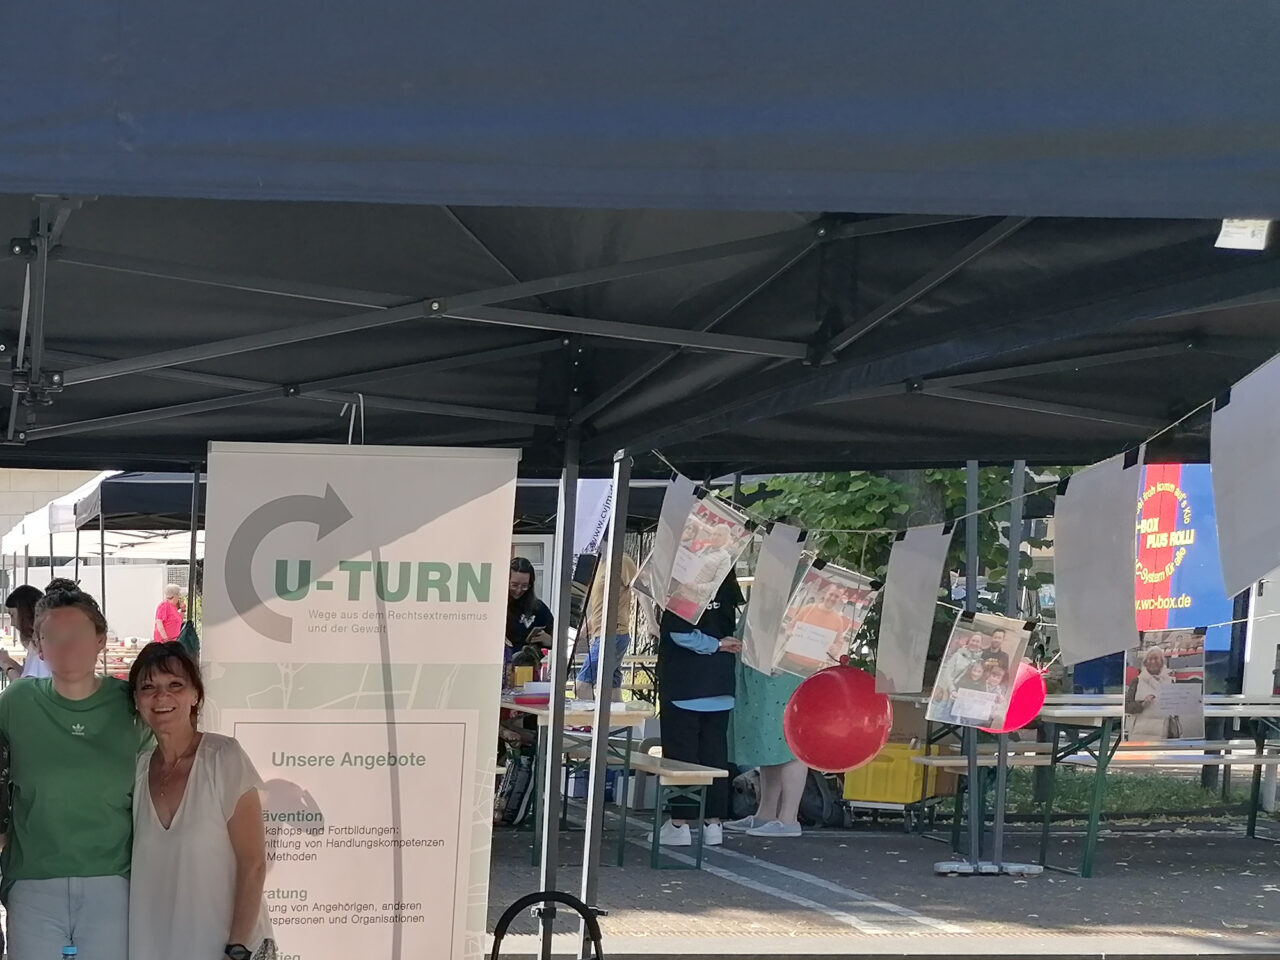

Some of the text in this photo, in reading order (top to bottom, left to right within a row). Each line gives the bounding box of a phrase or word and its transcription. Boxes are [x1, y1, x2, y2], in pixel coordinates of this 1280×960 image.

[1135, 517, 1159, 535] -BOX
[1146, 532, 1168, 549] PLUS
[274, 559, 492, 603] U-TURN
[309, 610, 488, 622] Wege aus dem Rechtsextremismus
[308, 623, 386, 633] und der Gewalt
[271, 751, 426, 770] Unsere Angebote
[263, 810, 323, 822] ävention
[265, 825, 399, 837] kshops und Fortbildungen:
[304, 840, 323, 848] von
[326, 838, 444, 850] Handlungskompetenzen
[267, 852, 317, 861] Methoden
[269, 901, 422, 913] ung von Angehörigen, anderen
[272, 913, 425, 926] spersonen und Organisationen
